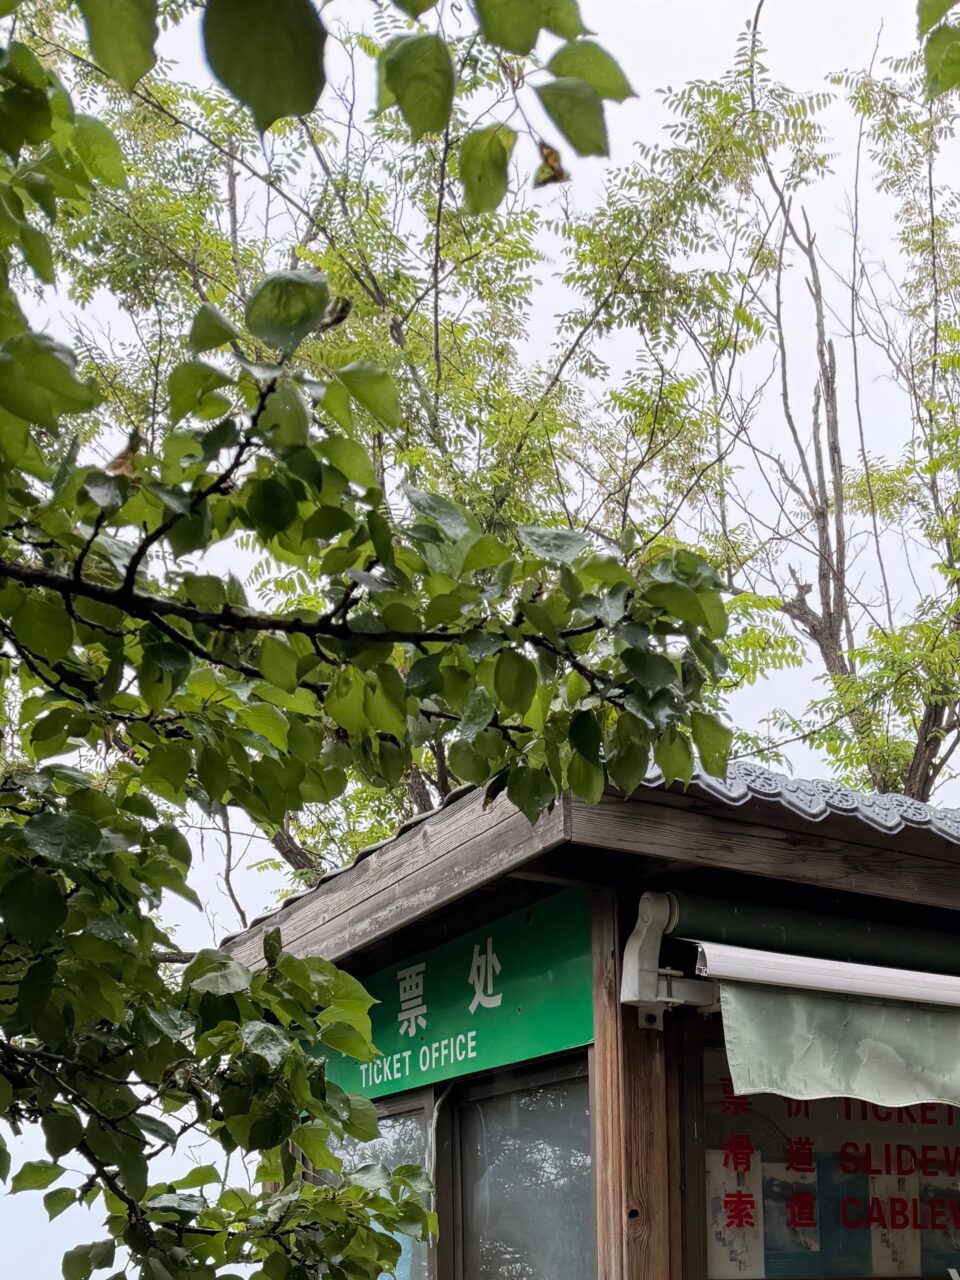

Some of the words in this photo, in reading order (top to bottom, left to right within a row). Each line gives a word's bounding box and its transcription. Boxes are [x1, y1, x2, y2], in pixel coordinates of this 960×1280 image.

[360, 1050, 412, 1088] TICKET
[419, 1030, 477, 1072] OFFICE
[723, 1192, 817, 1229] 索道
